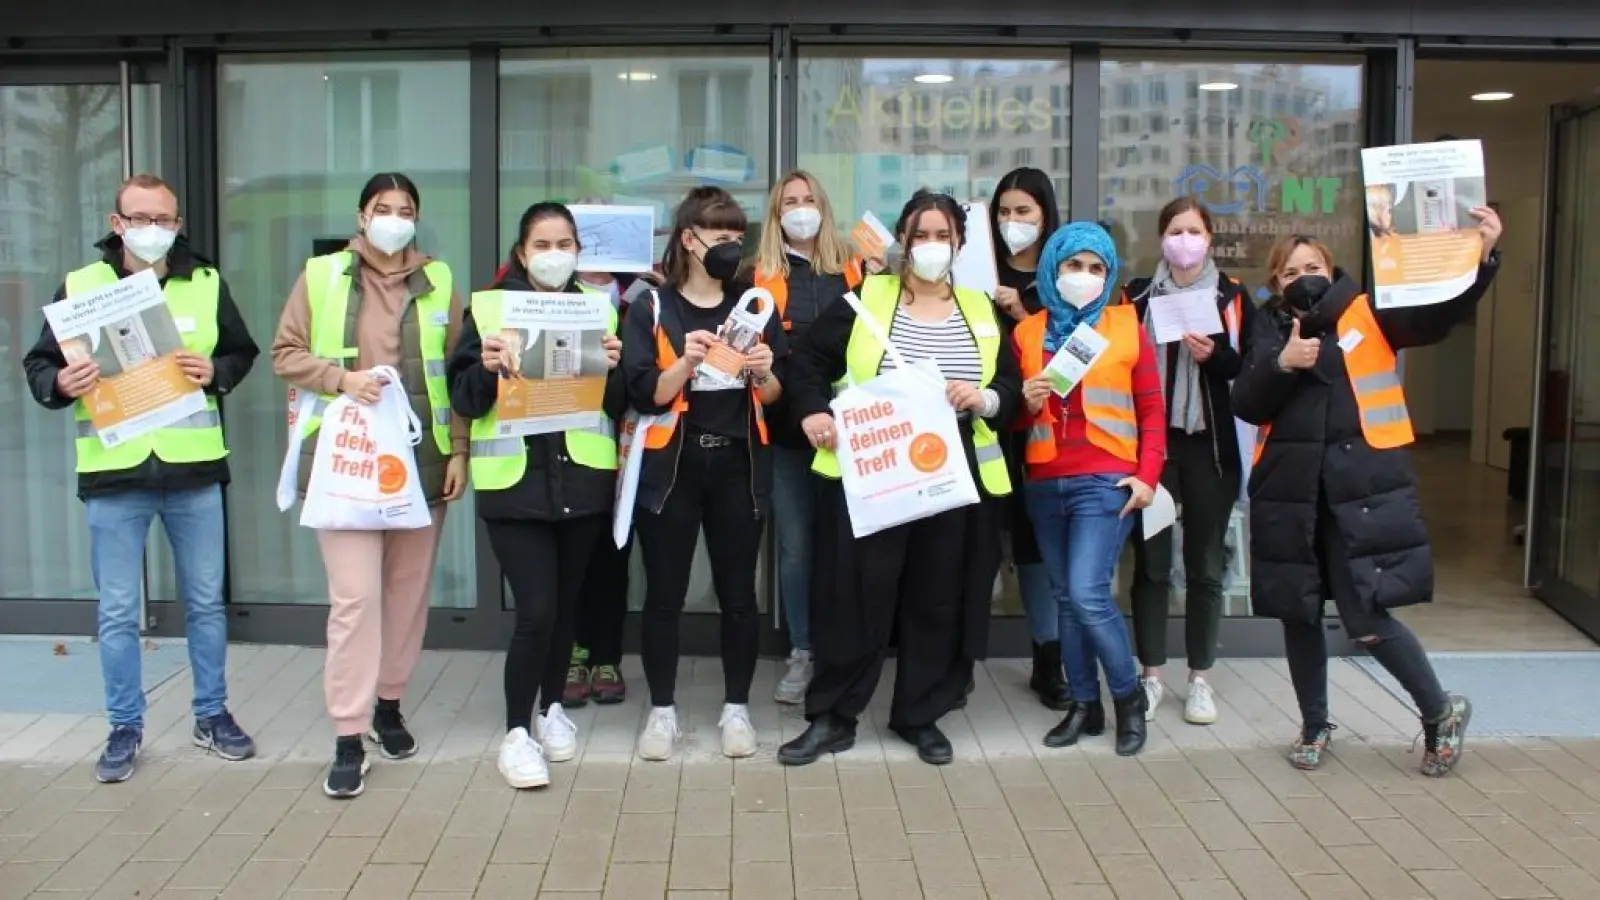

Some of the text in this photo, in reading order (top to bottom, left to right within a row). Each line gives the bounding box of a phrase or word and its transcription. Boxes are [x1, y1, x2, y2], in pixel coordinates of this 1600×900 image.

[828, 84, 1052, 130] Aktuelles
[1281, 177, 1342, 213] NT
[842, 401, 894, 428] Finde
[850, 421, 913, 451] deinen
[855, 448, 897, 476] Treff
